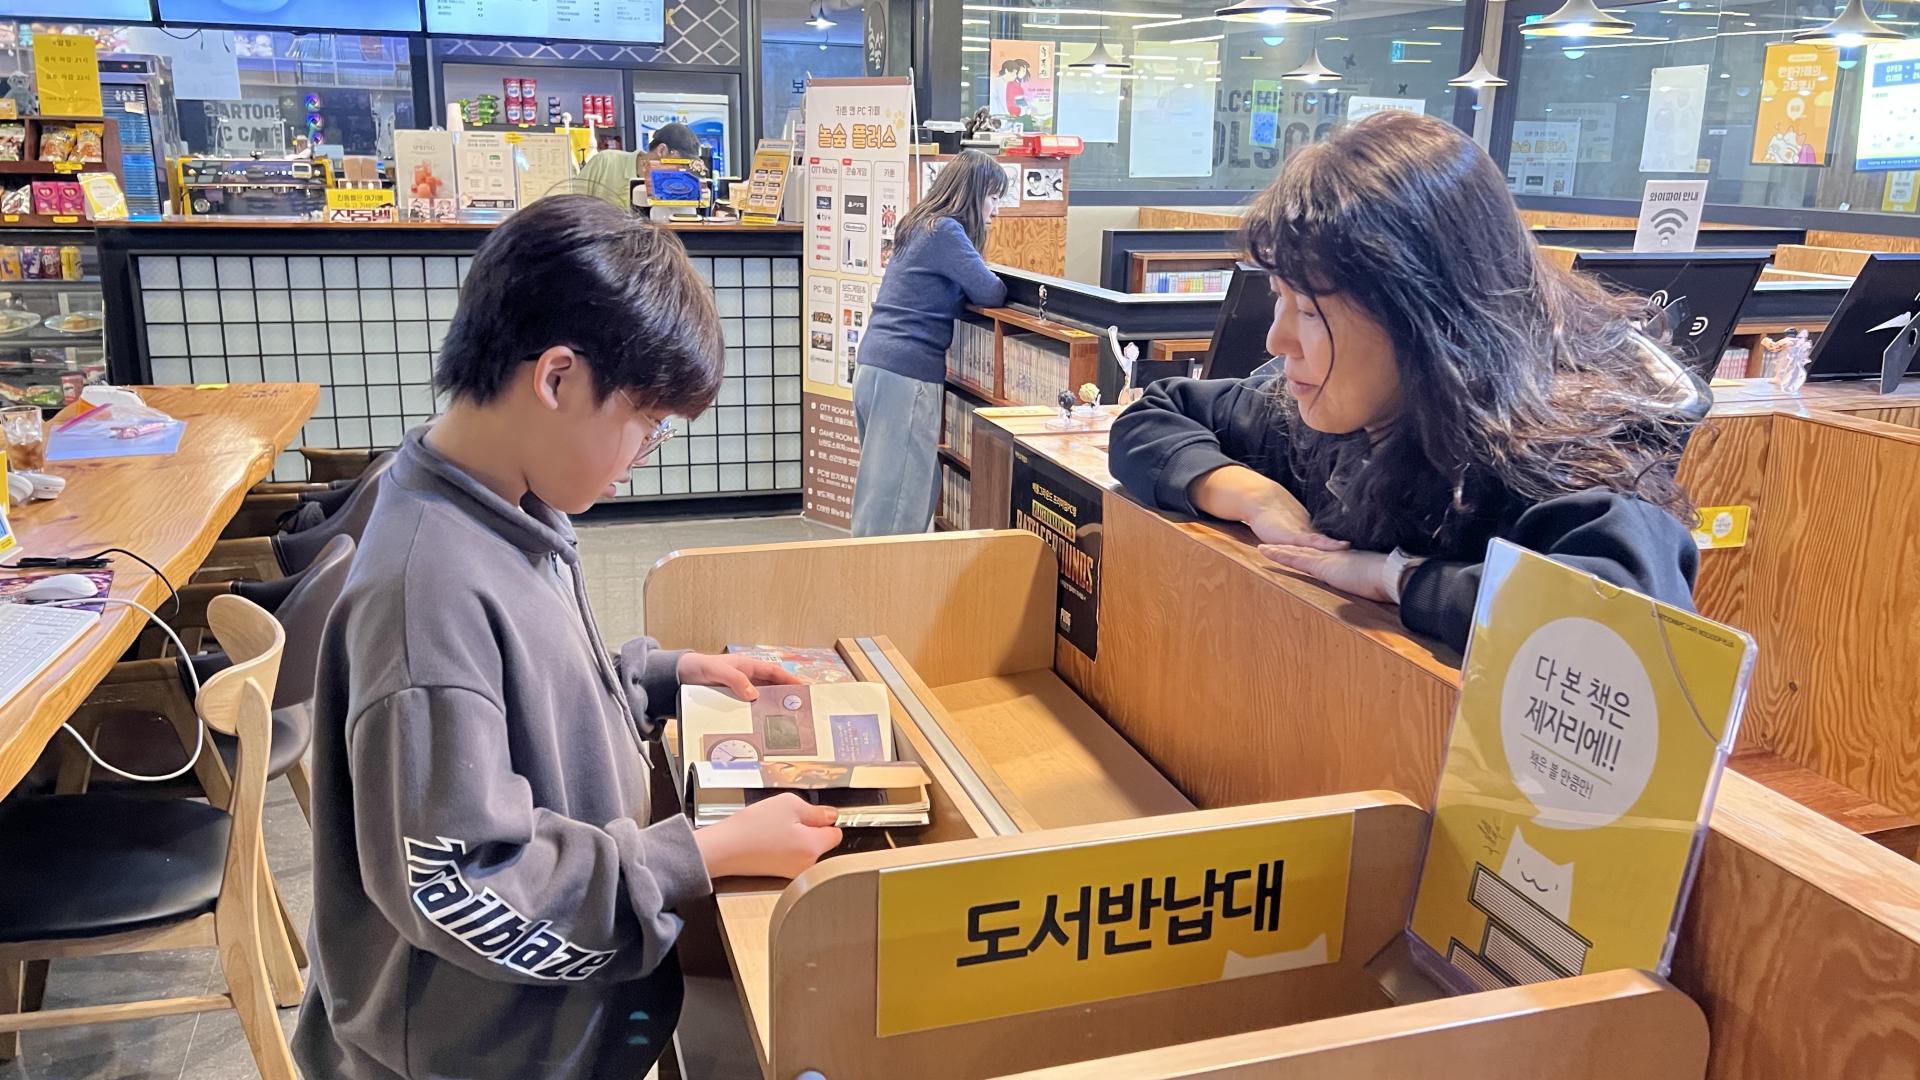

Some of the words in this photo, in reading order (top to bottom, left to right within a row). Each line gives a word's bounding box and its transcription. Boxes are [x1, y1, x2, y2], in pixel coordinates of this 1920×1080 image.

[818, 122, 848, 149] 놀숲
[852, 124, 897, 150] 플러스
[1649, 192, 1681, 202] 와이파이
[1682, 191, 1700, 202] 안내
[1536, 655, 1558, 692] 다
[1560, 667, 1582, 706] 본
[1587, 678, 1631, 730] 책은
[1524, 695, 1622, 772] 제자리에!!
[1529, 750, 1548, 774] 책은
[1560, 768, 1594, 800] 만큼만!
[956, 860, 1285, 967] 도서반납대
